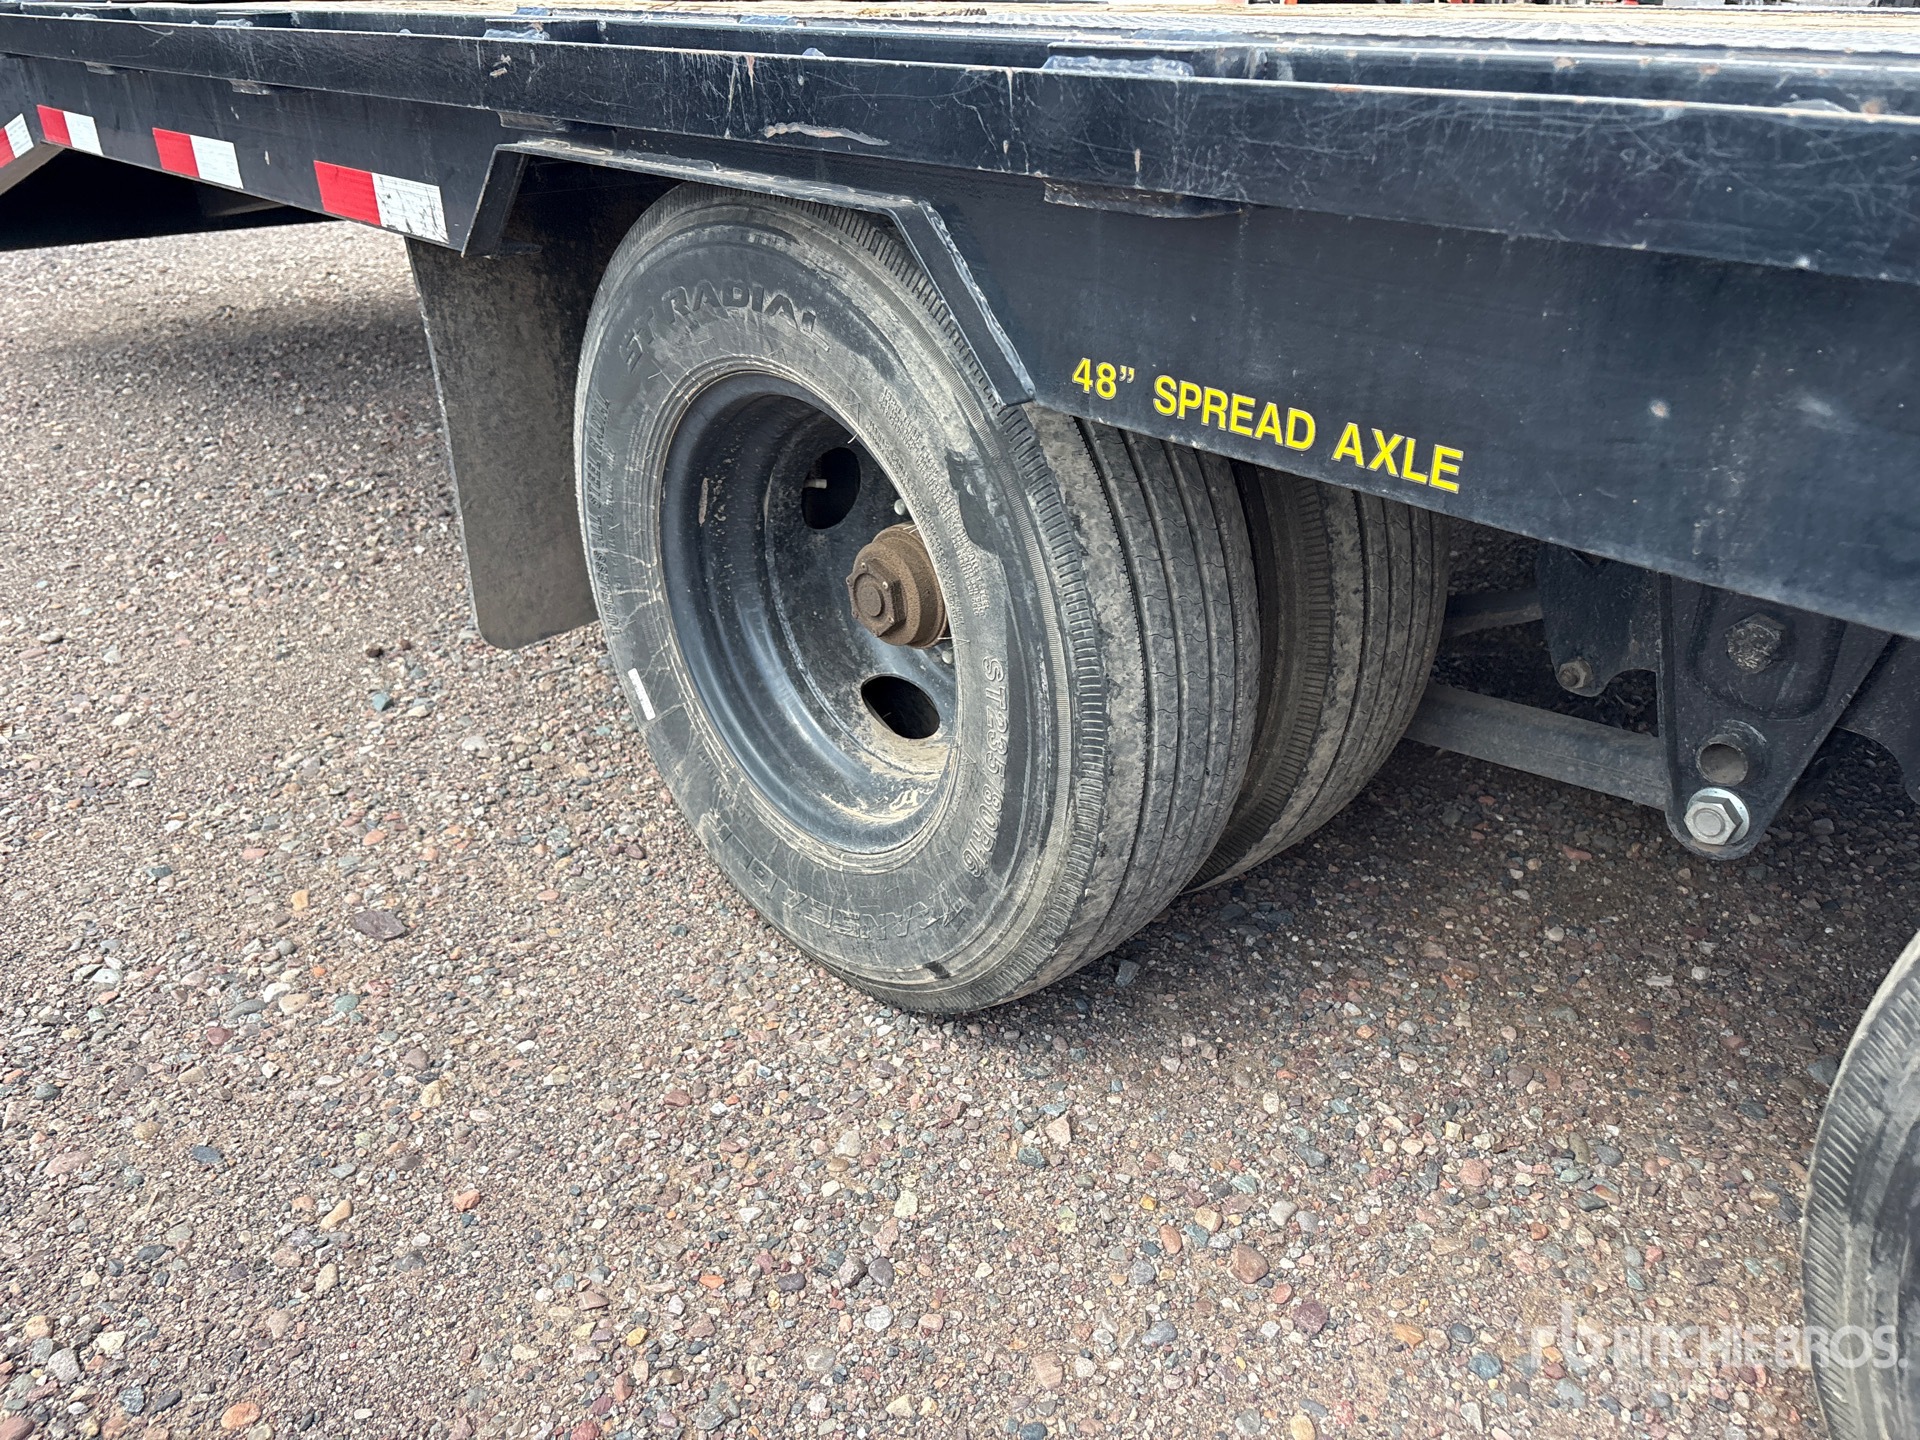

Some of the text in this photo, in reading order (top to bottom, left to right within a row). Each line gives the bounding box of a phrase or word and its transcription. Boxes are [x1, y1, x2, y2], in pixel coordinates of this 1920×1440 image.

[660, 278, 831, 352] RADIAL
[587, 390, 608, 460] RADIAL
[1152, 374, 1317, 451] SPREAD
[1330, 421, 1465, 494] AXLE
[585, 449, 602, 512] STEEL
[587, 508, 605, 548] ALL
[961, 655, 1010, 879] ST235/80R16
